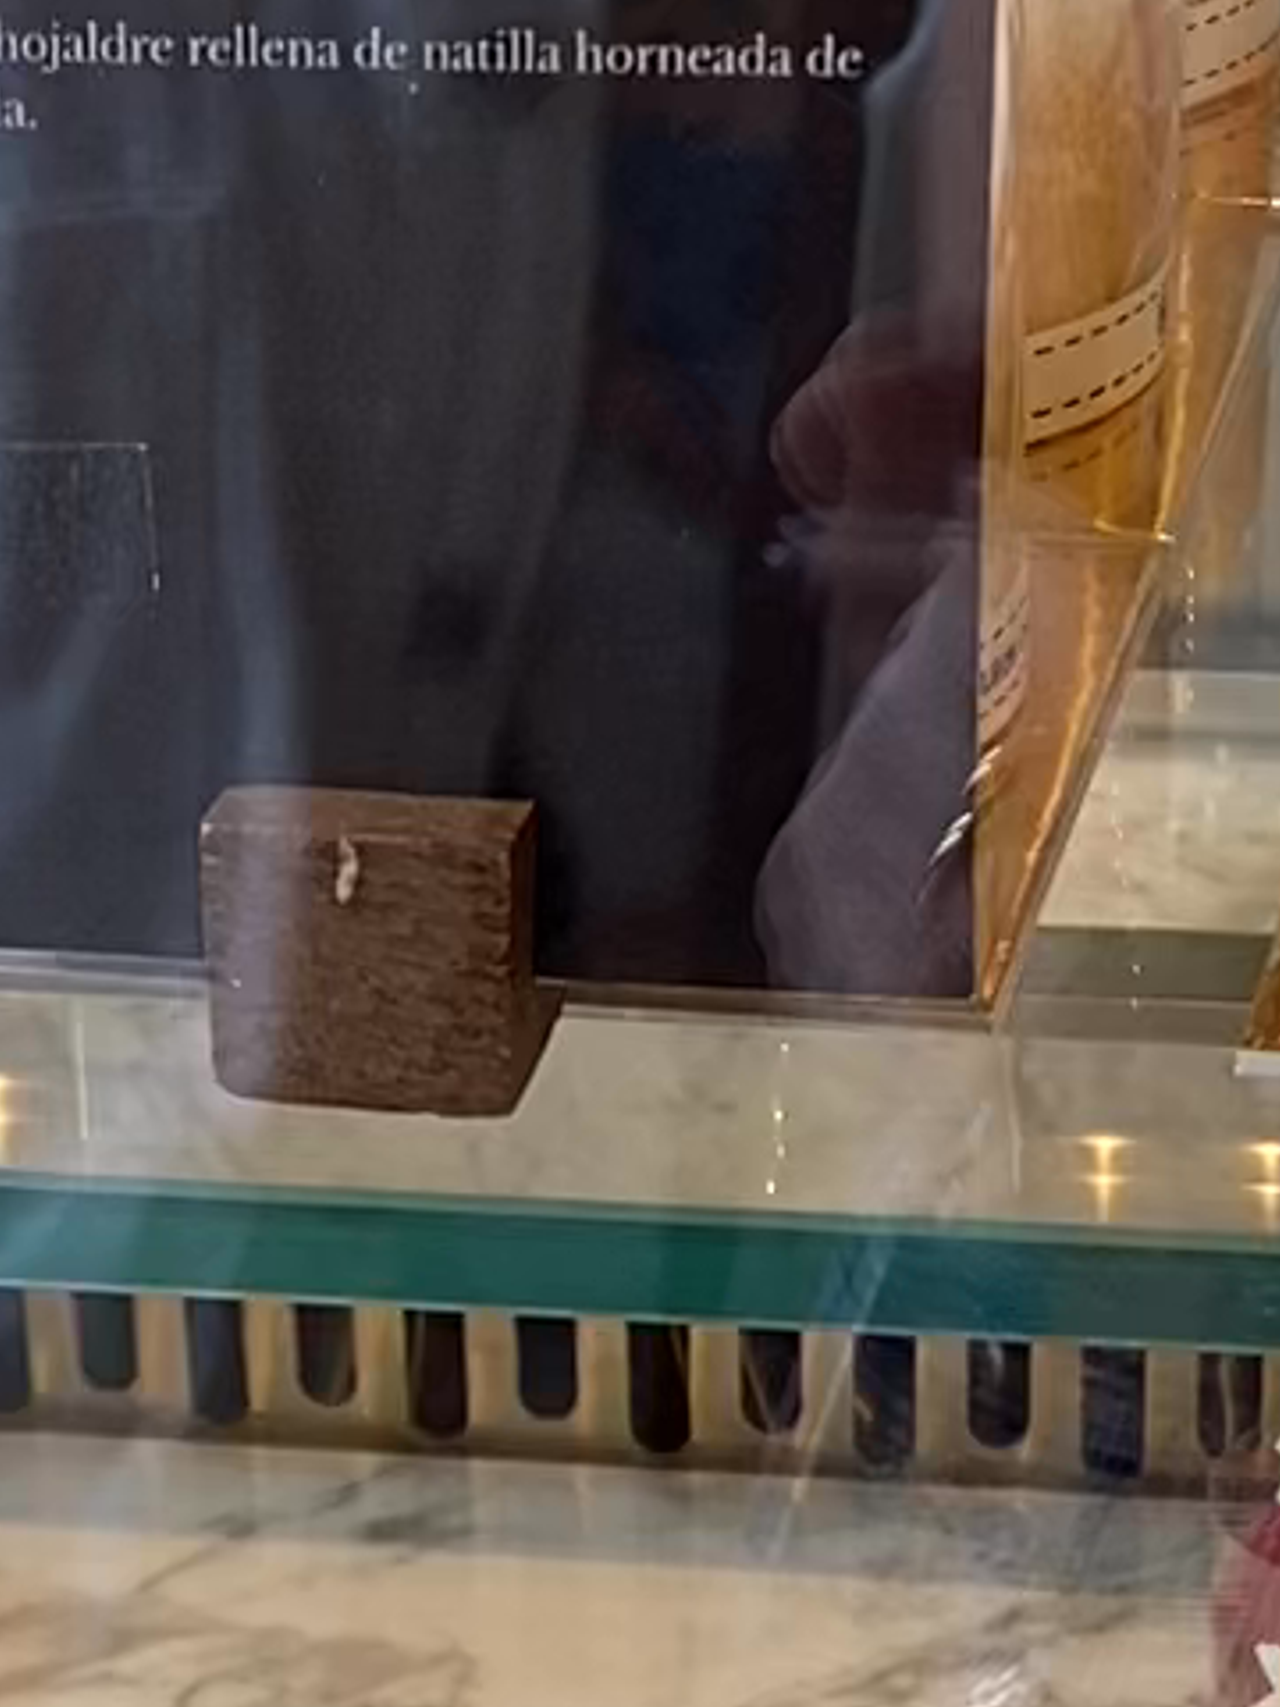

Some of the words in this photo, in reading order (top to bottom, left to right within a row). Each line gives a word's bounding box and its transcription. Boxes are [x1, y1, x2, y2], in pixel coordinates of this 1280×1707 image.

[188, 23, 341, 70] rellena
[352, 26, 410, 71] de
[423, 28, 562, 73] natilla
[575, 28, 792, 78] horneada
[804, 33, 866, 79] de
